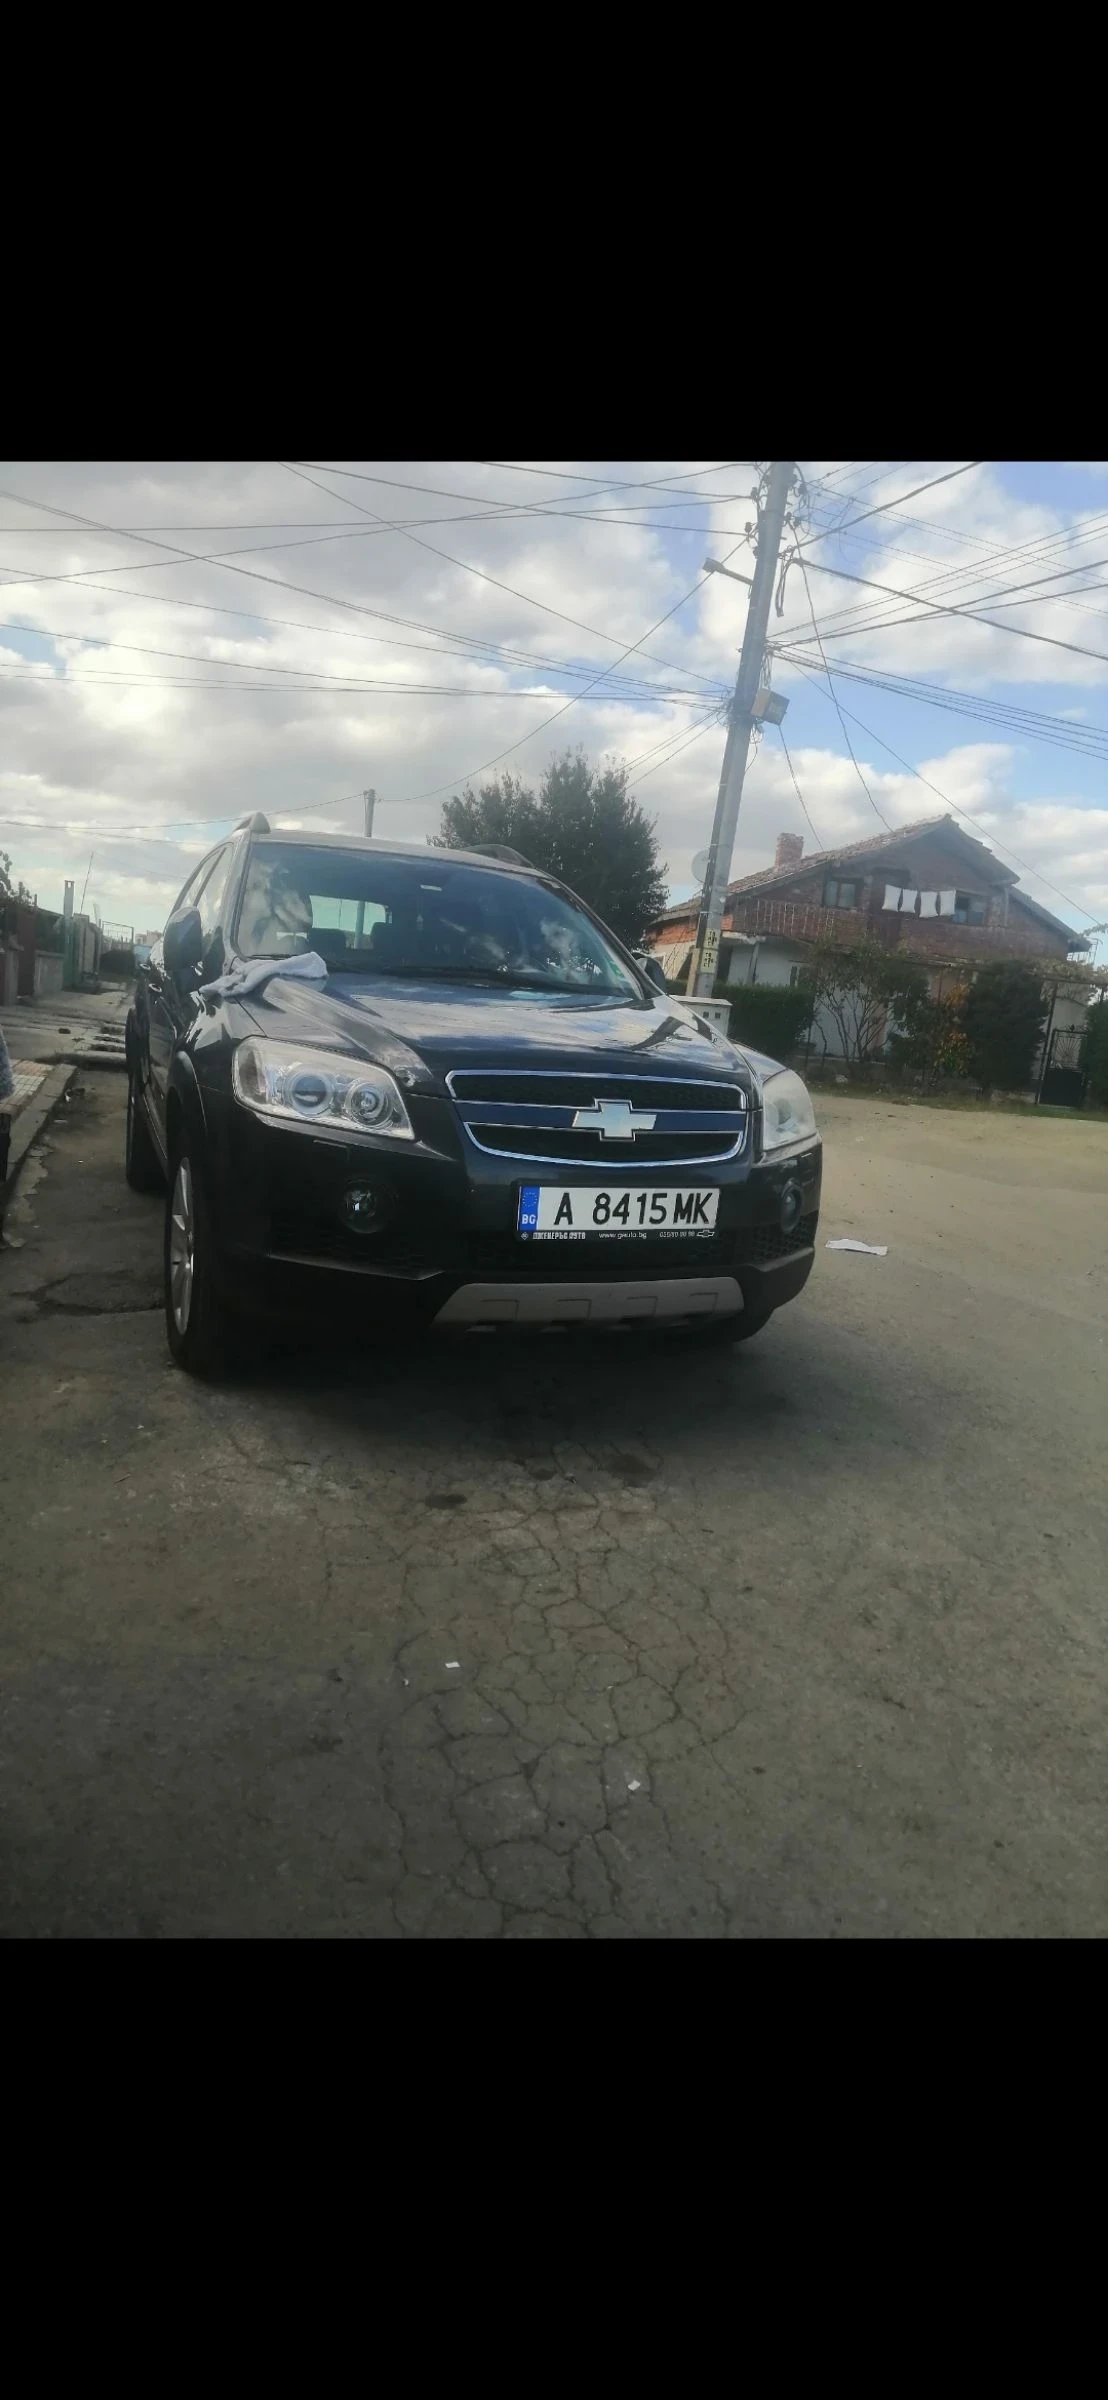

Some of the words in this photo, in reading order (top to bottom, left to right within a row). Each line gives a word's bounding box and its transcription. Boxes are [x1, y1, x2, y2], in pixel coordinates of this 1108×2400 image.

[553, 1192, 573, 1225] A
[592, 1192, 667, 1225] 8415
[673, 1192, 713, 1224] MK
[521, 1215, 536, 1225] BG
